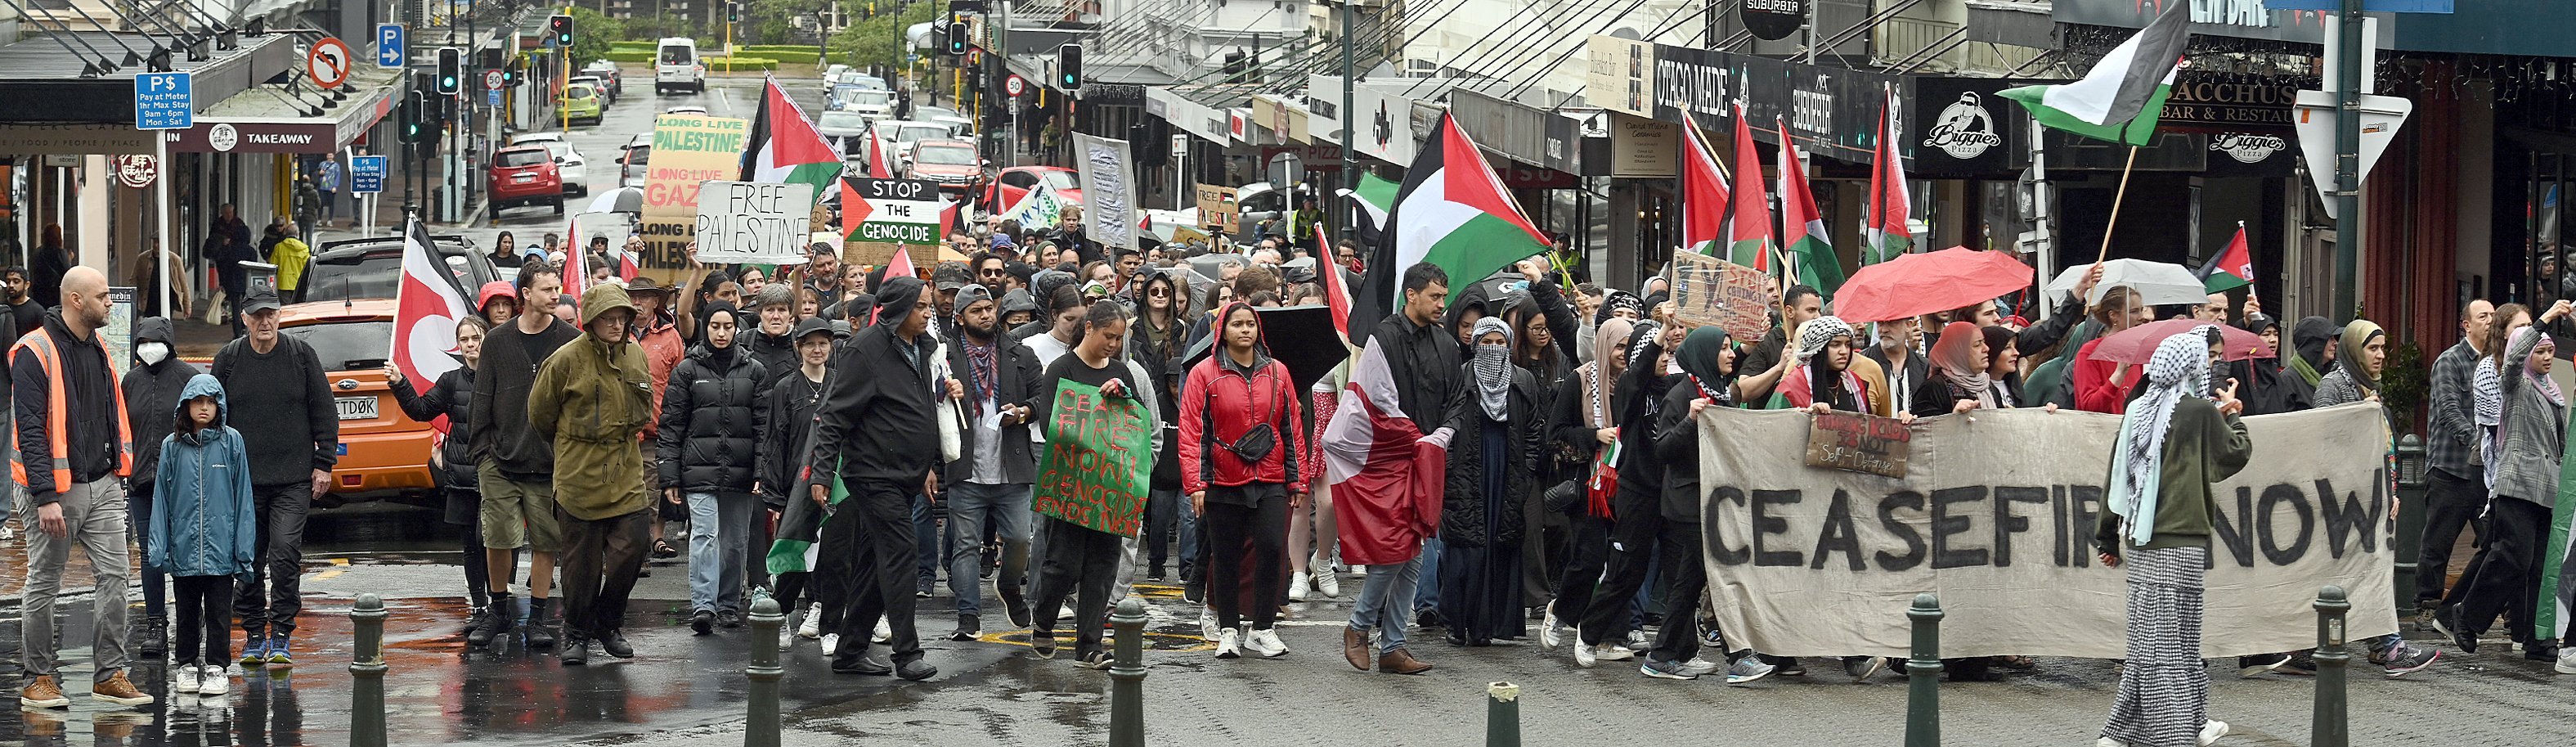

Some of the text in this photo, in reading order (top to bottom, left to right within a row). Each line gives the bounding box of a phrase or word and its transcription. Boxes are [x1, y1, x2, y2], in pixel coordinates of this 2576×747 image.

[1747, 0, 1798, 11] SUBURBIA
[384, 30, 397, 44] P
[489, 76, 500, 84] 50
[1010, 82, 1020, 90] 50
[1657, 59, 1692, 111] OTAGO
[1694, 64, 1728, 117] MADE
[140, 93, 153, 101] Pay
[1793, 89, 1832, 135] SUBURBIA
[2160, 106, 2195, 119] BAR
[2203, 106, 2216, 120] &
[658, 118, 743, 129] LONG LIVE
[167, 133, 180, 142] IN
[247, 133, 312, 144] TAKEAWAY
[653, 131, 742, 153] PALESTINE
[2237, 149, 2262, 157] Pizza
[650, 168, 722, 180] LONG LIVE
[647, 183, 700, 208] GAZ
[872, 180, 922, 198] STOP
[1199, 190, 1218, 201] FREE
[730, 184, 785, 214] FREE
[886, 205, 910, 217] THE
[1198, 207, 1237, 225] PALESTINE
[640, 223, 684, 236] LONG
[696, 214, 809, 255] PALESTINE
[863, 223, 930, 242] GENOCIDE
[1729, 266, 1767, 293] STOP
[110, 290, 131, 300] unedin
[1059, 389, 1144, 432] CEASE
[1057, 413, 1131, 452] FIRE
[1869, 418, 1911, 443] KIDS
[1837, 431, 1892, 456] IS NOT
[1053, 443, 1137, 488] NOW!
[1042, 470, 1148, 520] GENOCIDE
[1035, 497, 1092, 524] ENDS
[1099, 511, 1142, 537] NOW
[1706, 484, 2106, 571] CEASEFIR
